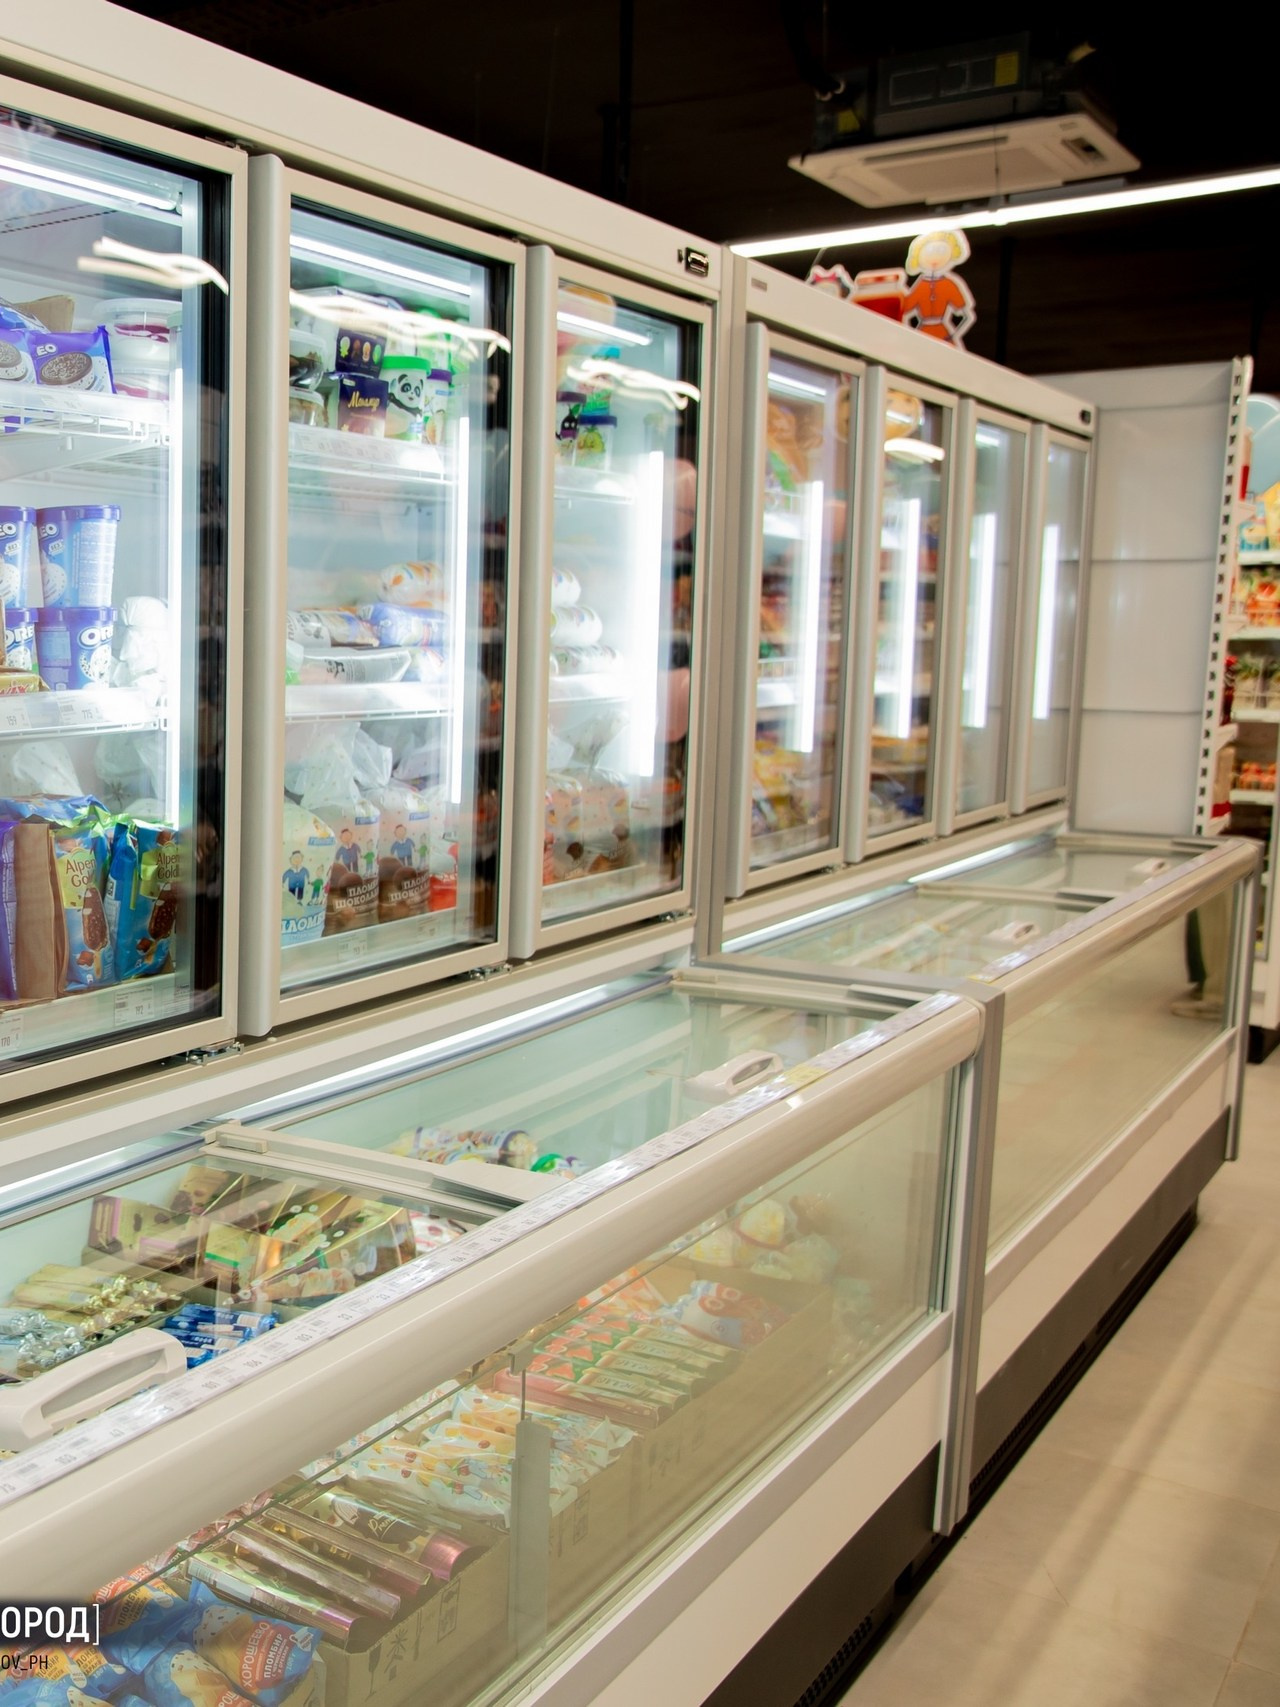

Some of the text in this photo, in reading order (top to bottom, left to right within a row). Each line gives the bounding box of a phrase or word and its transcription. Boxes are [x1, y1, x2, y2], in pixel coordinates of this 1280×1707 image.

[65, 857, 97, 875] Alpen
[241, 1621, 270, 1688] ХОРОШЕЕВО
[263, 1633, 284, 1679] ПЛОМБИР
